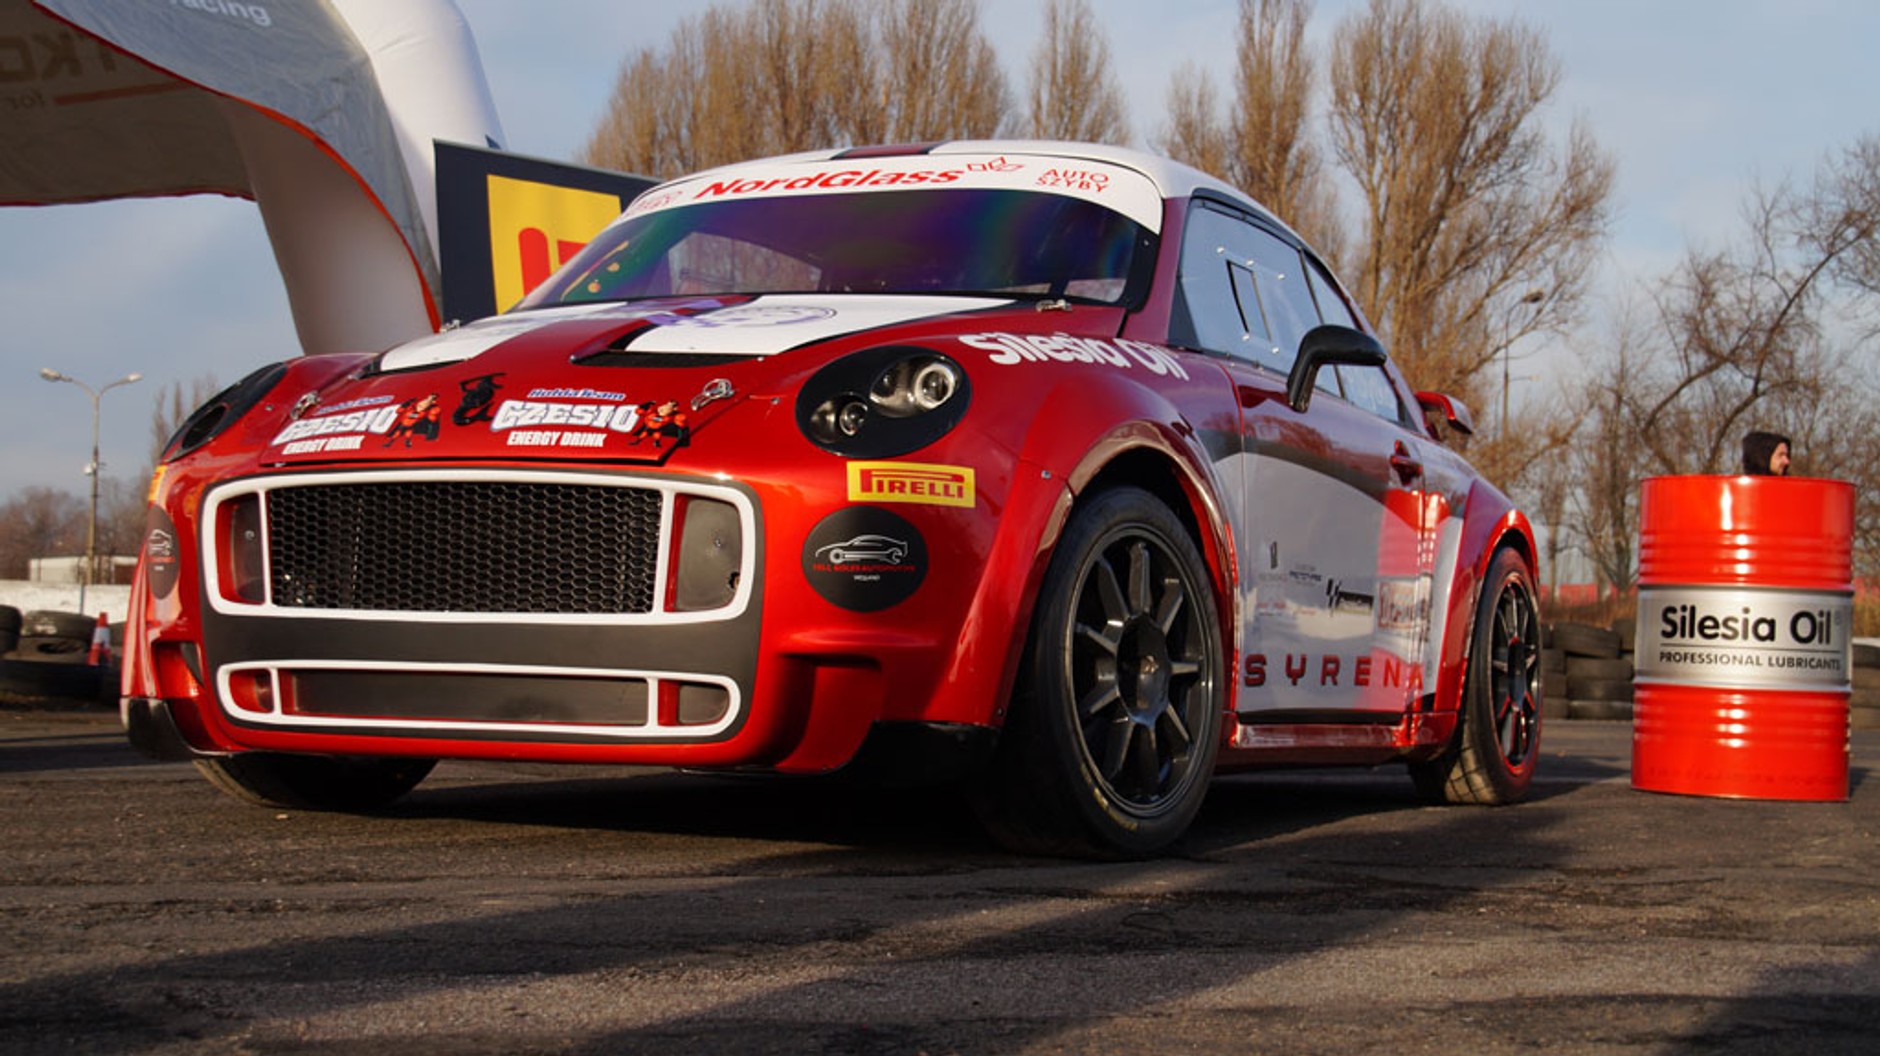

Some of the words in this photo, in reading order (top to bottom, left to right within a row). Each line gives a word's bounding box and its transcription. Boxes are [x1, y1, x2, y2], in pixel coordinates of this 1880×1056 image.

[694, 169, 965, 199] NordGlass
[1035, 176, 1108, 193] SZYBY
[1047, 168, 1109, 184] AUTO
[958, 332, 1132, 369] Silesia
[490, 399, 640, 433] CZESIO
[507, 431, 561, 446] ENERGY
[560, 432, 607, 447] DRINK
[860, 469, 965, 499] PIRELLI
[1661, 604, 1776, 642] Silesia
[1790, 609, 1832, 645] Oil
[1244, 653, 1424, 690] SYRENA
[1660, 651, 1764, 667] PROFESSIONAL
[1768, 655, 1842, 671] LUBRICANTS
